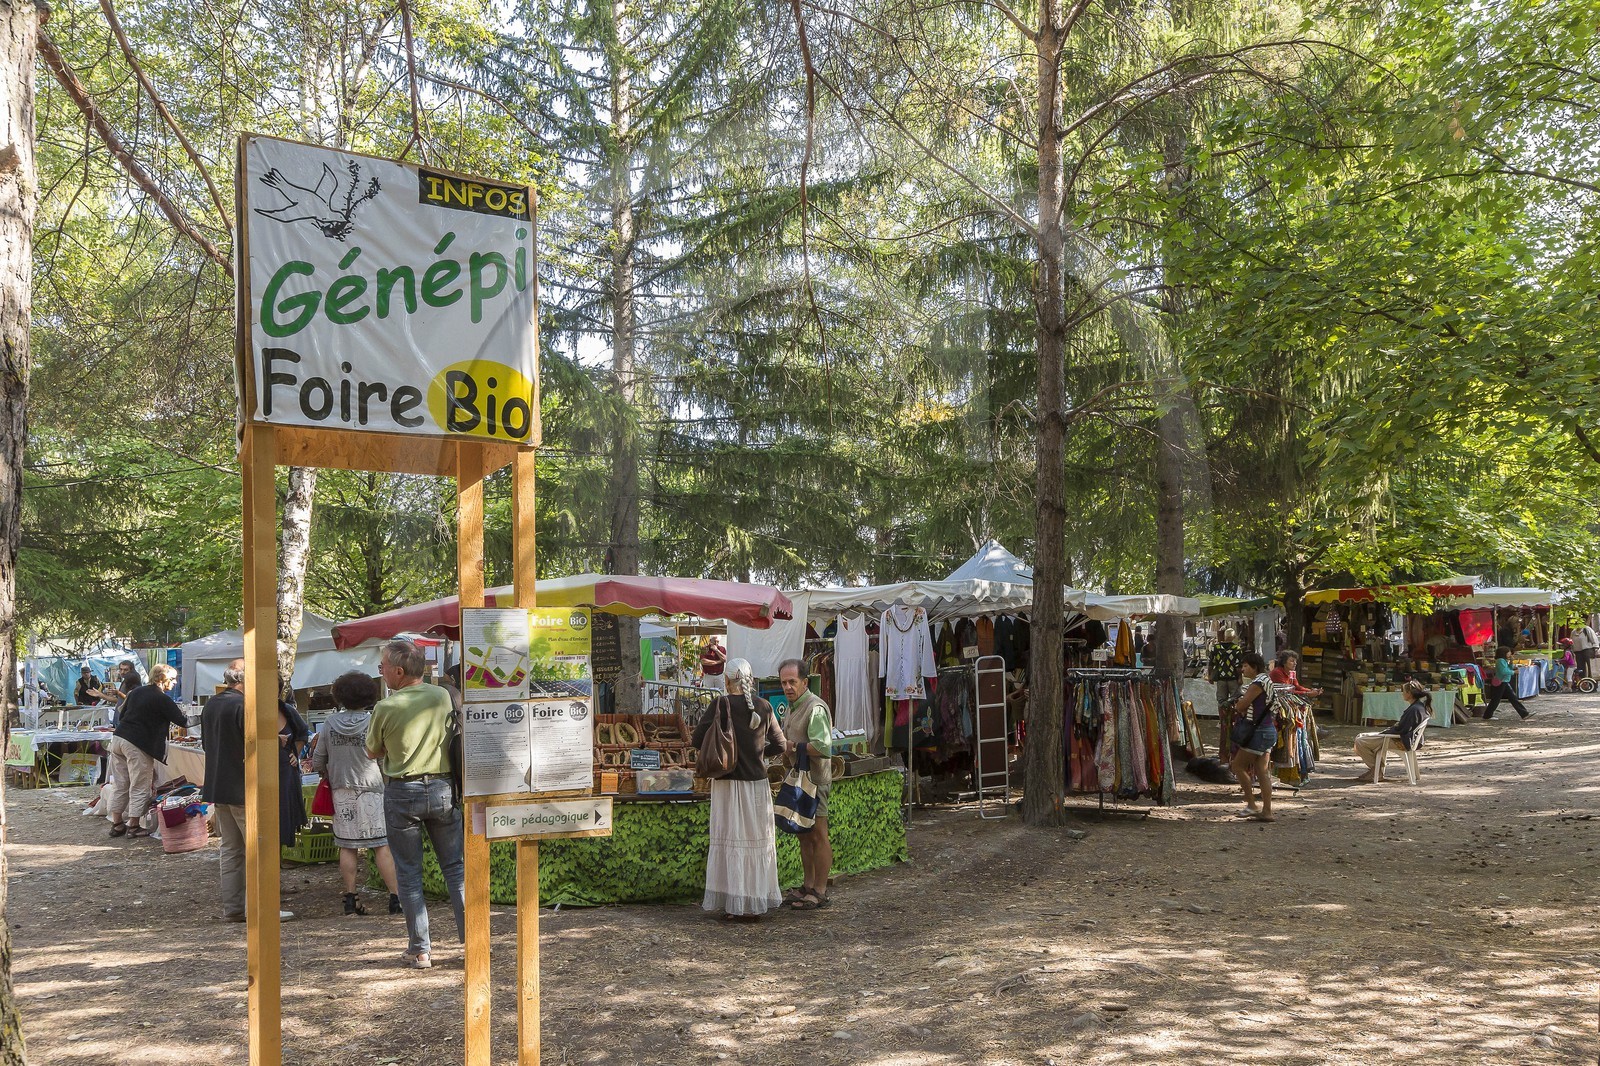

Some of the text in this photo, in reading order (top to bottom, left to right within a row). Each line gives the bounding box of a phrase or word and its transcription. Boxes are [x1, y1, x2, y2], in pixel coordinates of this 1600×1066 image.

[427, 176, 526, 215] INFOS
[260, 227, 528, 338] Génépi
[262, 347, 530, 439] Foire Bio
[531, 615, 564, 626] Foire
[466, 709, 498, 720] Foire
[532, 707, 564, 718] Foire
[492, 812, 589, 828] Pôle pédagogique
